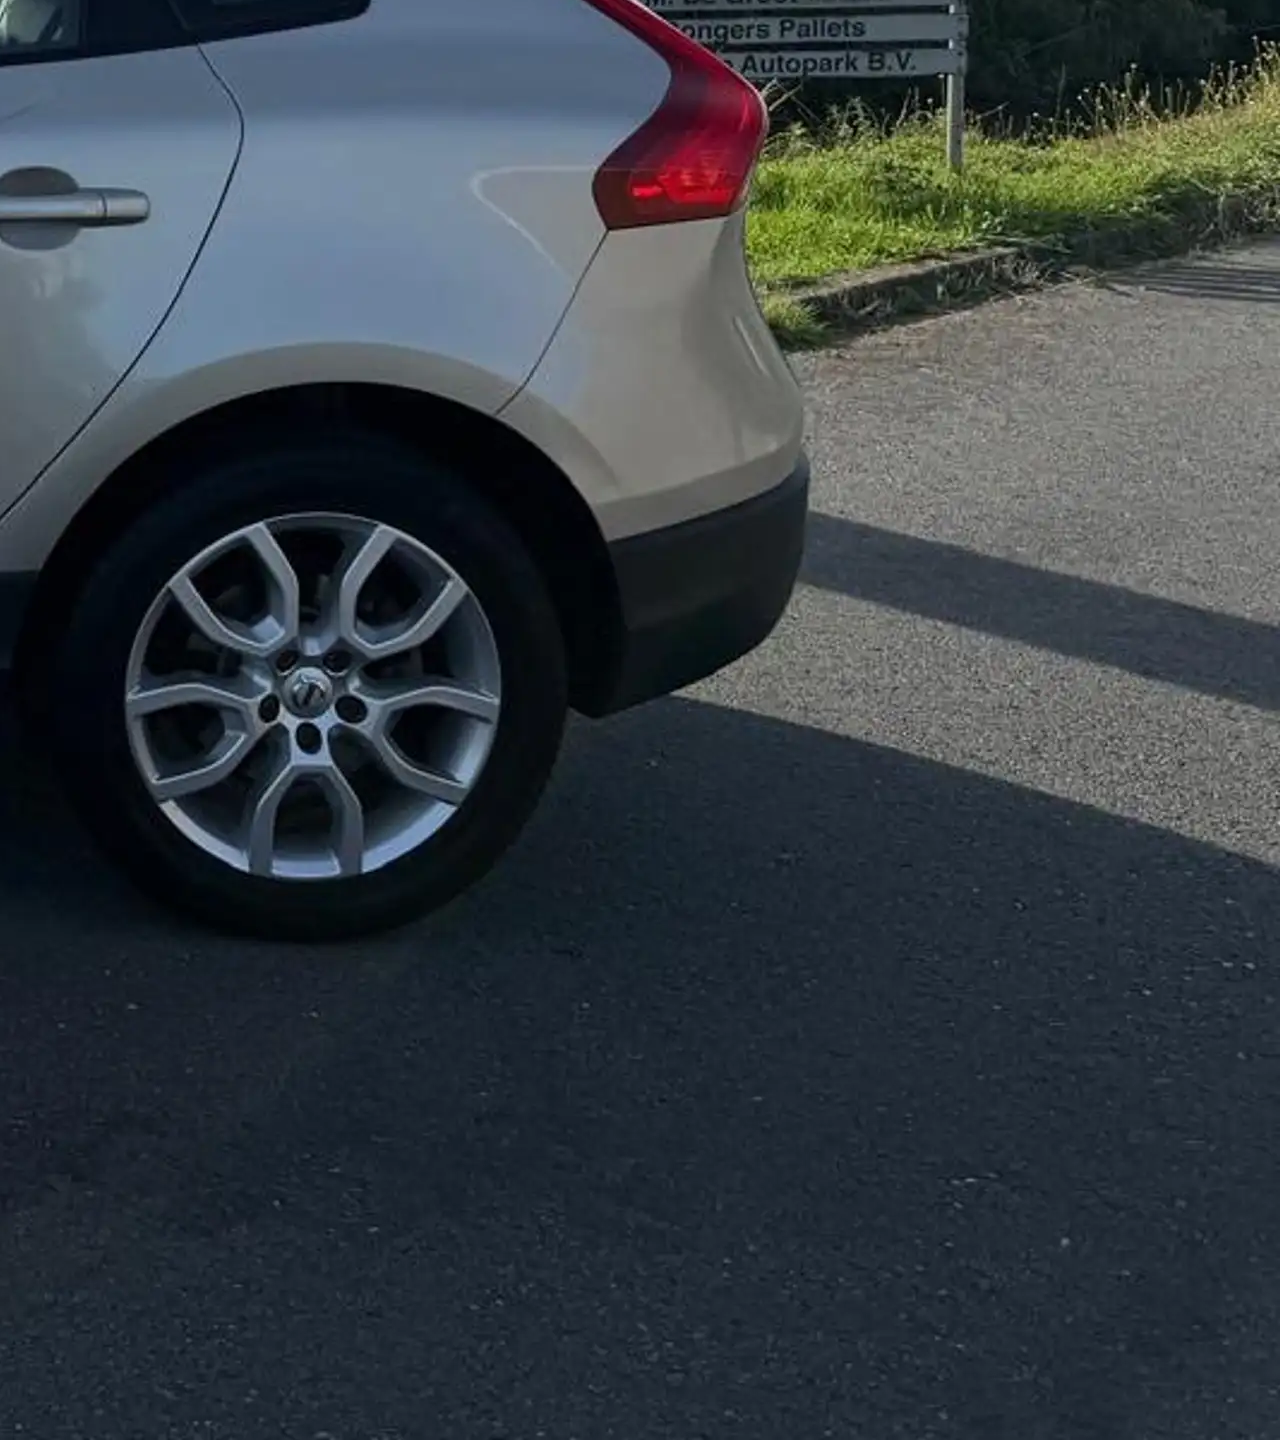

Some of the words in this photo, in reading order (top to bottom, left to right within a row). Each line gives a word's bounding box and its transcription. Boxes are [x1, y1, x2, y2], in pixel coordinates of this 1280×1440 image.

[669, 19, 771, 41] ongers
[780, 18, 866, 39] Pallets
[742, 51, 859, 78] Autopark
[868, 51, 917, 72] B.V.
